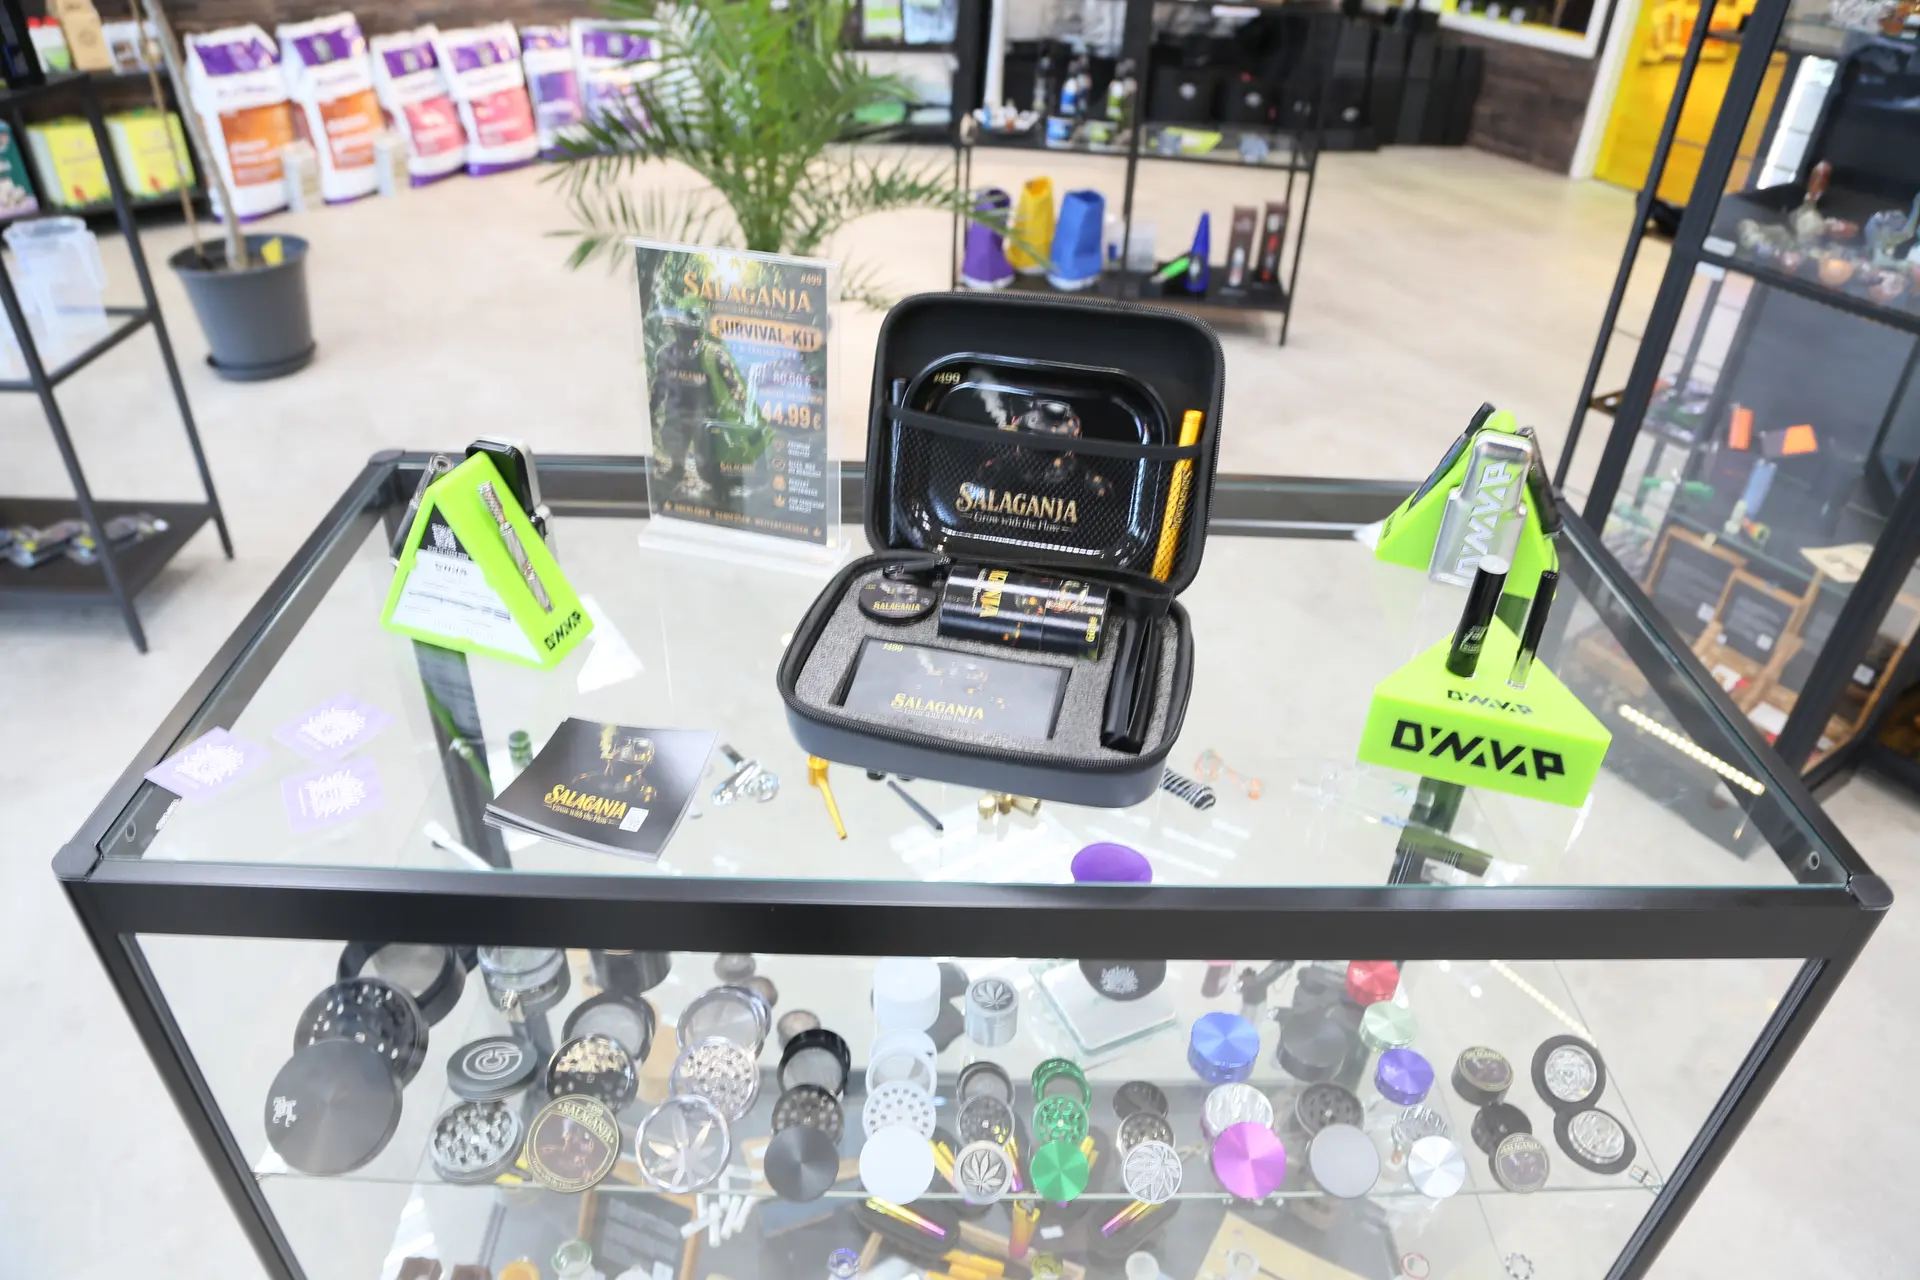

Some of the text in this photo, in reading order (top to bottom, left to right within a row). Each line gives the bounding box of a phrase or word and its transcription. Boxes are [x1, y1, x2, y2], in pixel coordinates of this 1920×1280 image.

[683, 271, 813, 314] SALAGANJA
[800, 272, 822, 287] #499
[933, 372, 961, 385] #499
[761, 400, 822, 430] 44.99 €
[955, 481, 1078, 524] SALAGANJA
[973, 510, 1061, 534] Grow with the Flow
[890, 692, 984, 721] SALAGANJA
[543, 783, 628, 820] SALAGANJA
[560, 1102, 612, 1142] SALAGANJA
